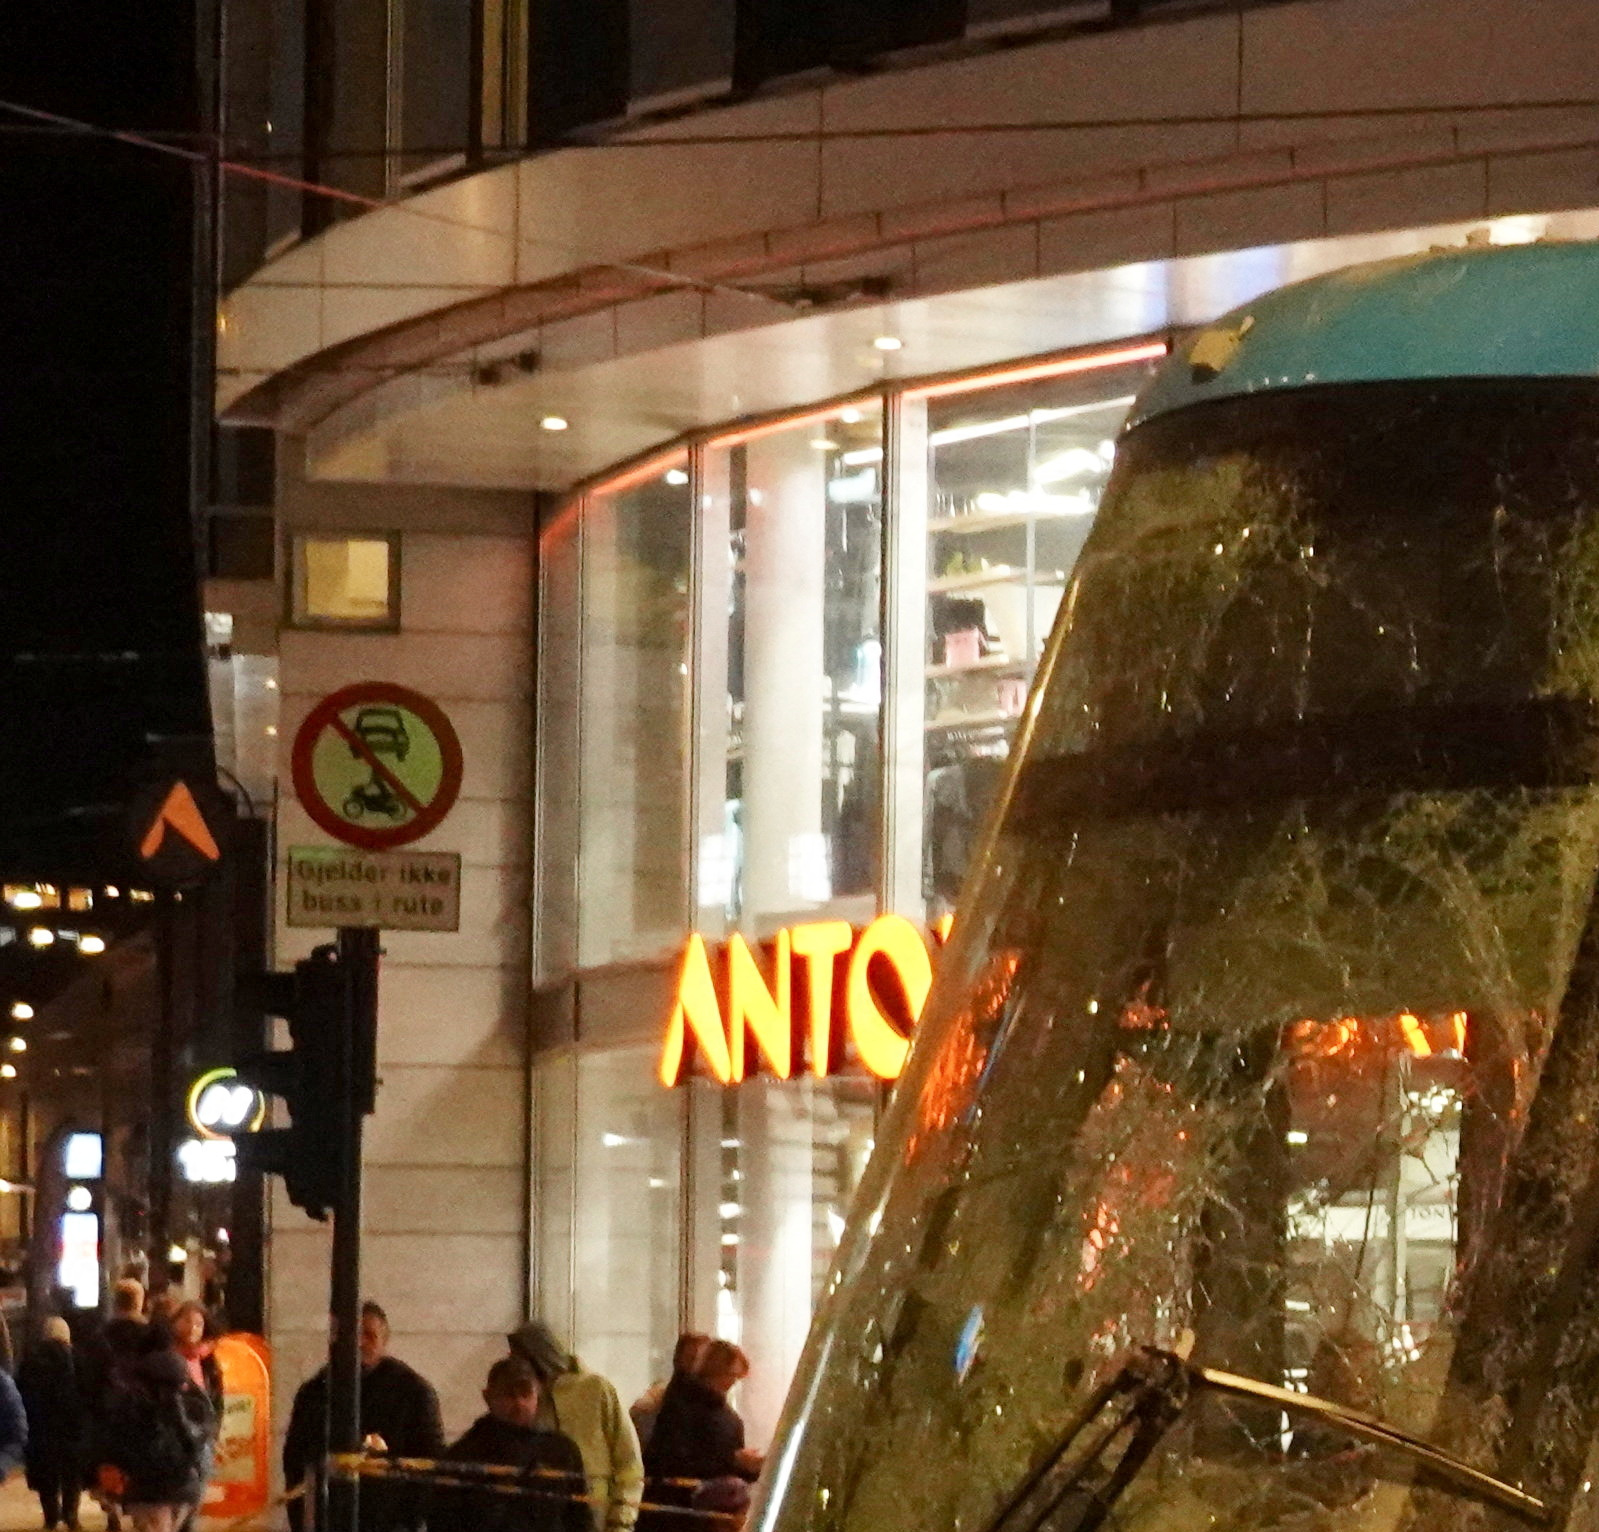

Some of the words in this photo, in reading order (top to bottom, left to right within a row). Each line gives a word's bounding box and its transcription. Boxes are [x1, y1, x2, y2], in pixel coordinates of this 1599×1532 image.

[295, 860, 387, 886] Gjelder
[400, 862, 451, 884] ikke
[302, 889, 362, 912] buss
[392, 894, 445, 915] rute
[660, 912, 954, 1088] ANTO
